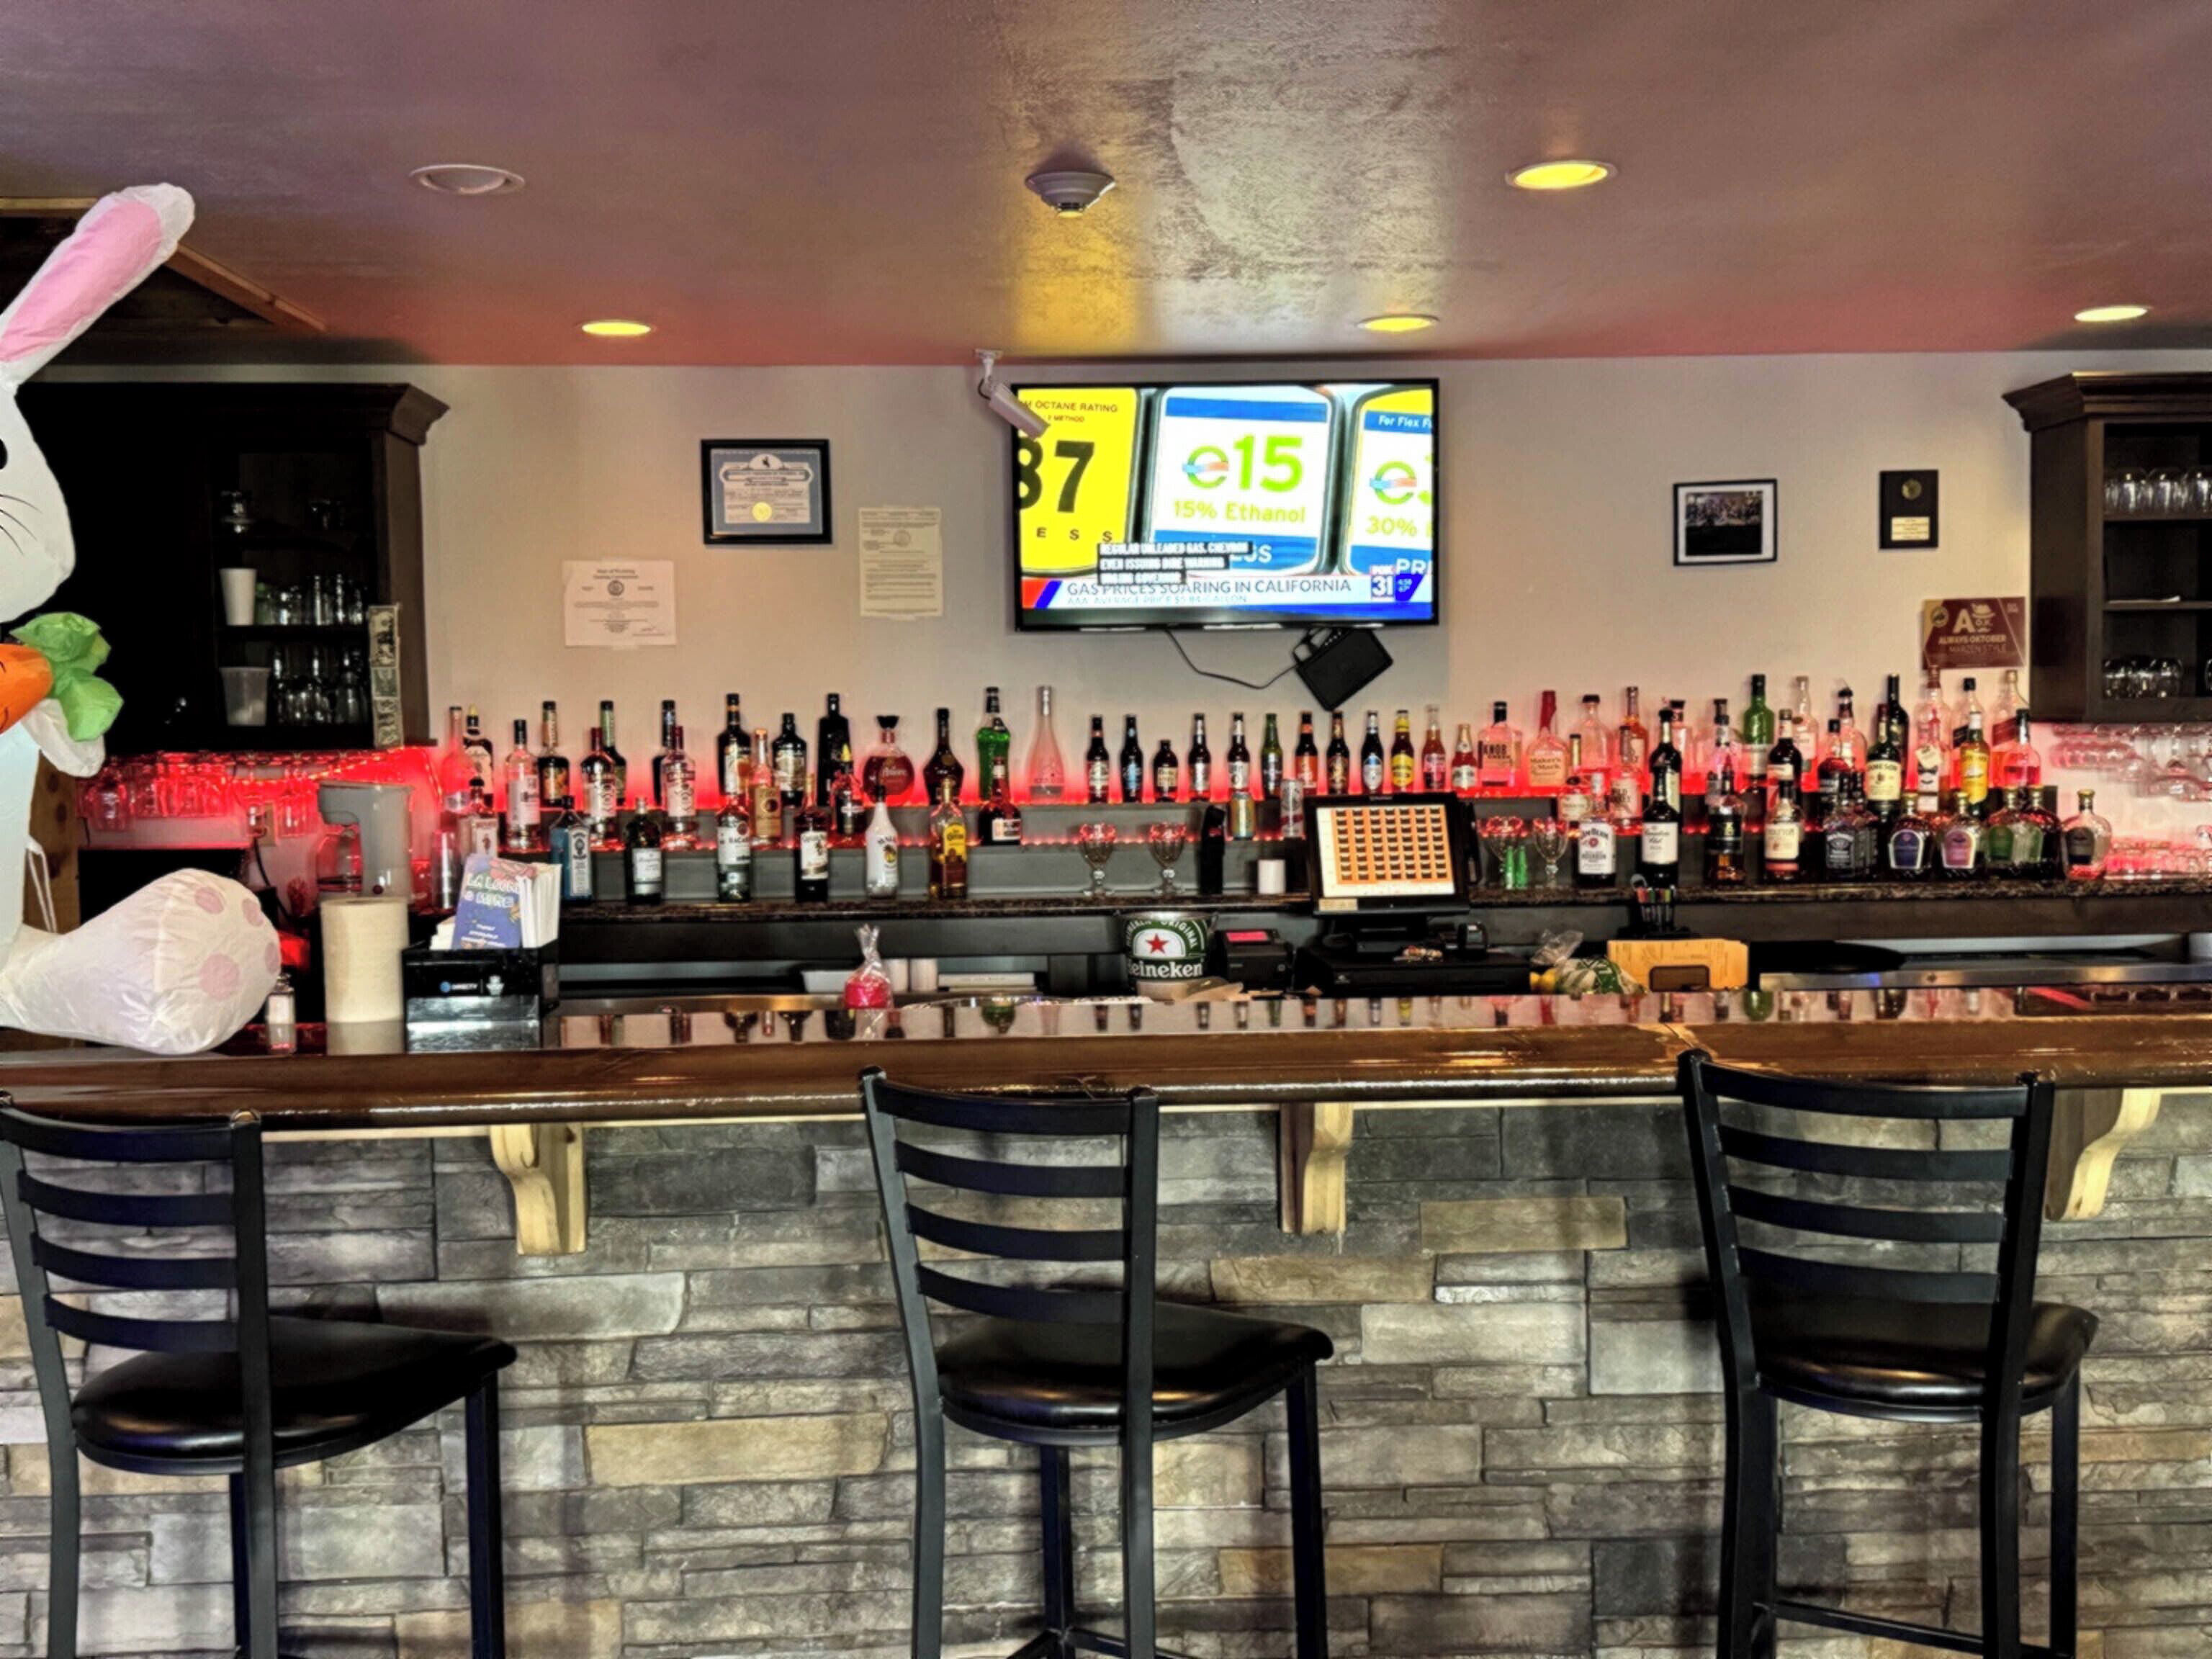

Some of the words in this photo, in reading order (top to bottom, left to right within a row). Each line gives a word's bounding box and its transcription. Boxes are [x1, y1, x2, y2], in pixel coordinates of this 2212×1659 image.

[1035, 400, 1077, 411] OCTANE
[1079, 403, 1118, 413] RATING
[1377, 414, 1395, 426] For
[1397, 416, 1419, 428] Flex
[1172, 499, 1218, 520] 15%
[1225, 500, 1305, 523] Ethanol
[1366, 516, 1419, 537] 30%
[1067, 583, 1099, 595] GAS
[1102, 583, 1156, 595] PRICES
[1160, 580, 1231, 594] SOARING
[1235, 580, 1251, 593] IN
[1255, 579, 1352, 593] CALIFORNIA
[1372, 576, 1393, 597] 31
[1128, 960, 1203, 979] eineken
